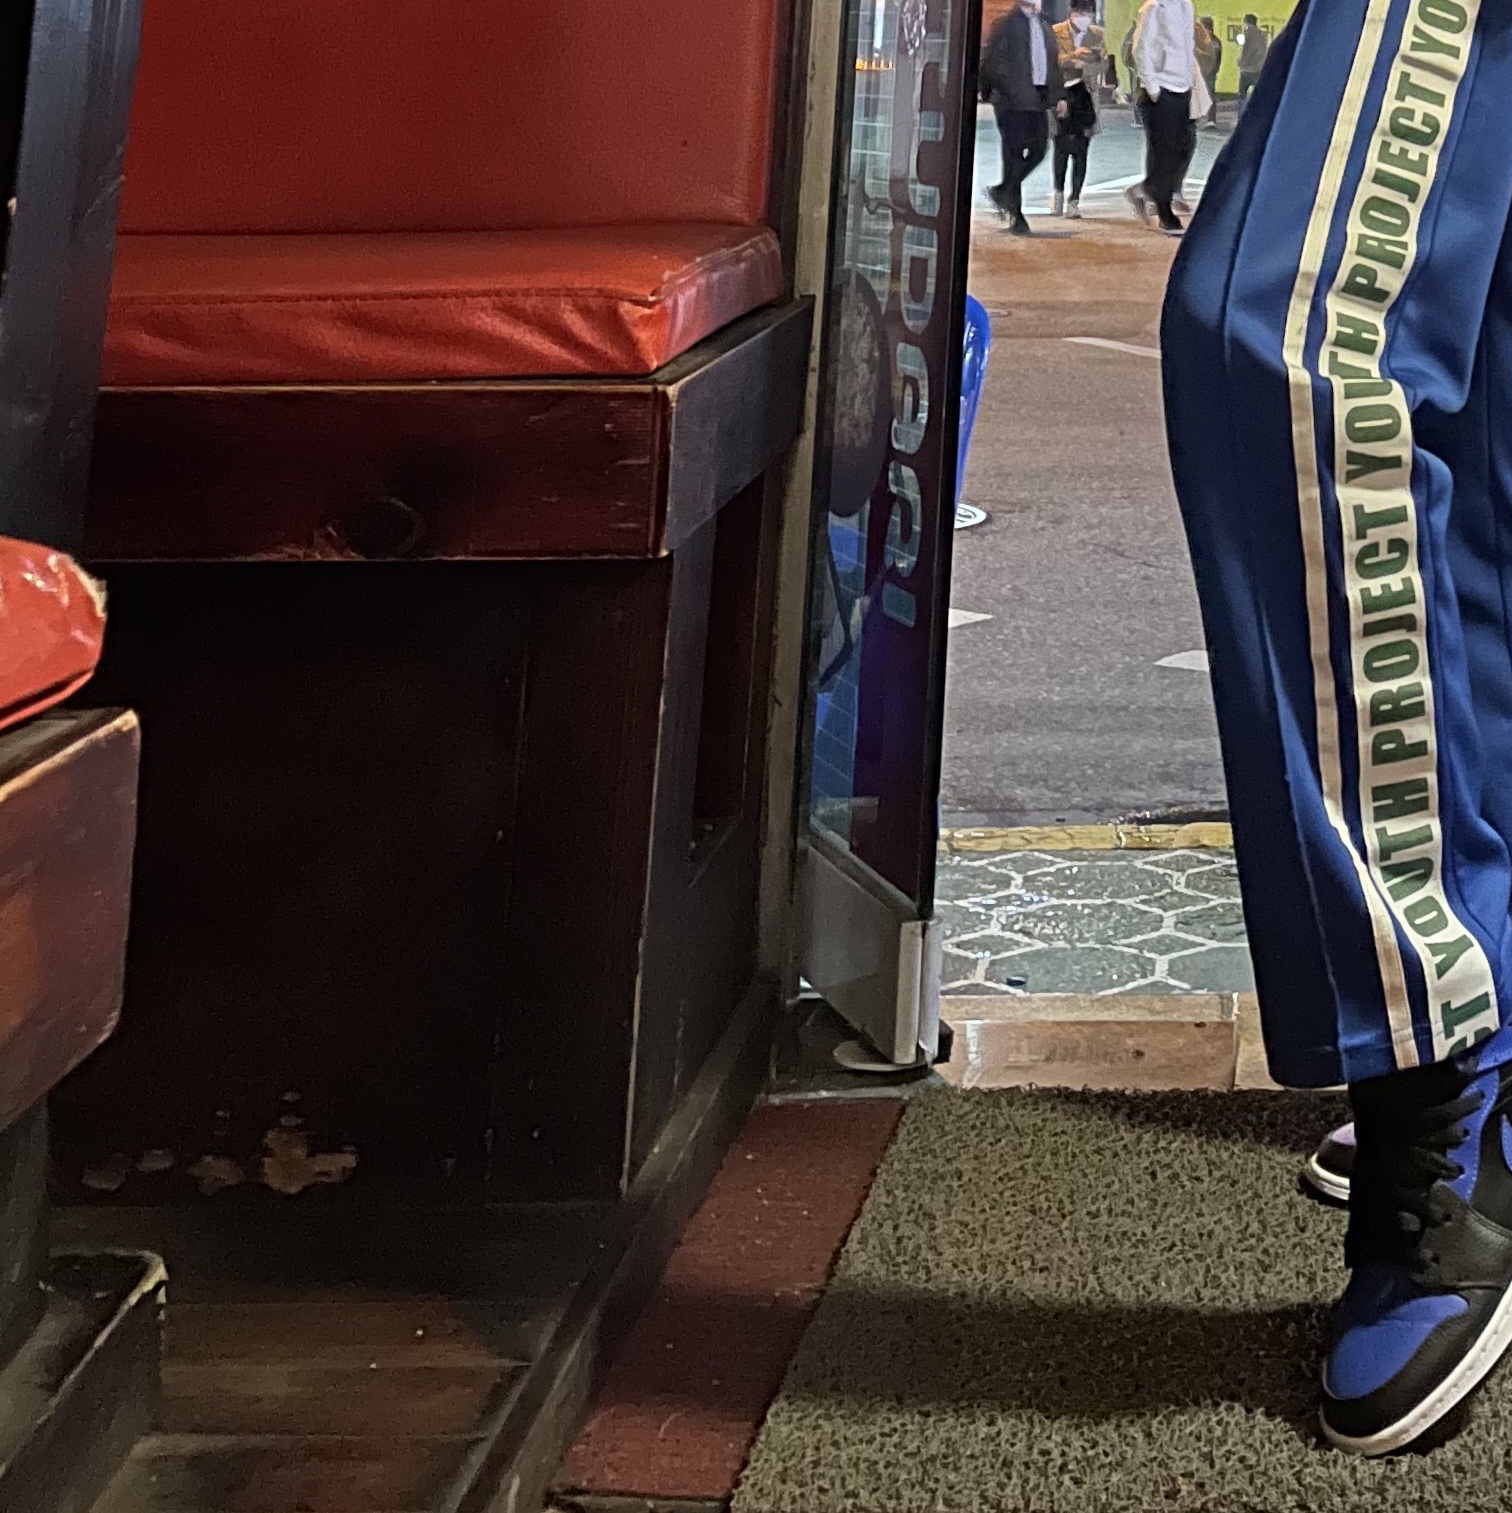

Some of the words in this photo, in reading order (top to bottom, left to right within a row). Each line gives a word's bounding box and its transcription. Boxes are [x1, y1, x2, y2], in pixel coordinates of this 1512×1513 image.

[1343, 72, 1450, 305] PROJECT
[1351, 502, 1432, 764] PROJECT
[1369, 777, 1476, 976] YOUTH
